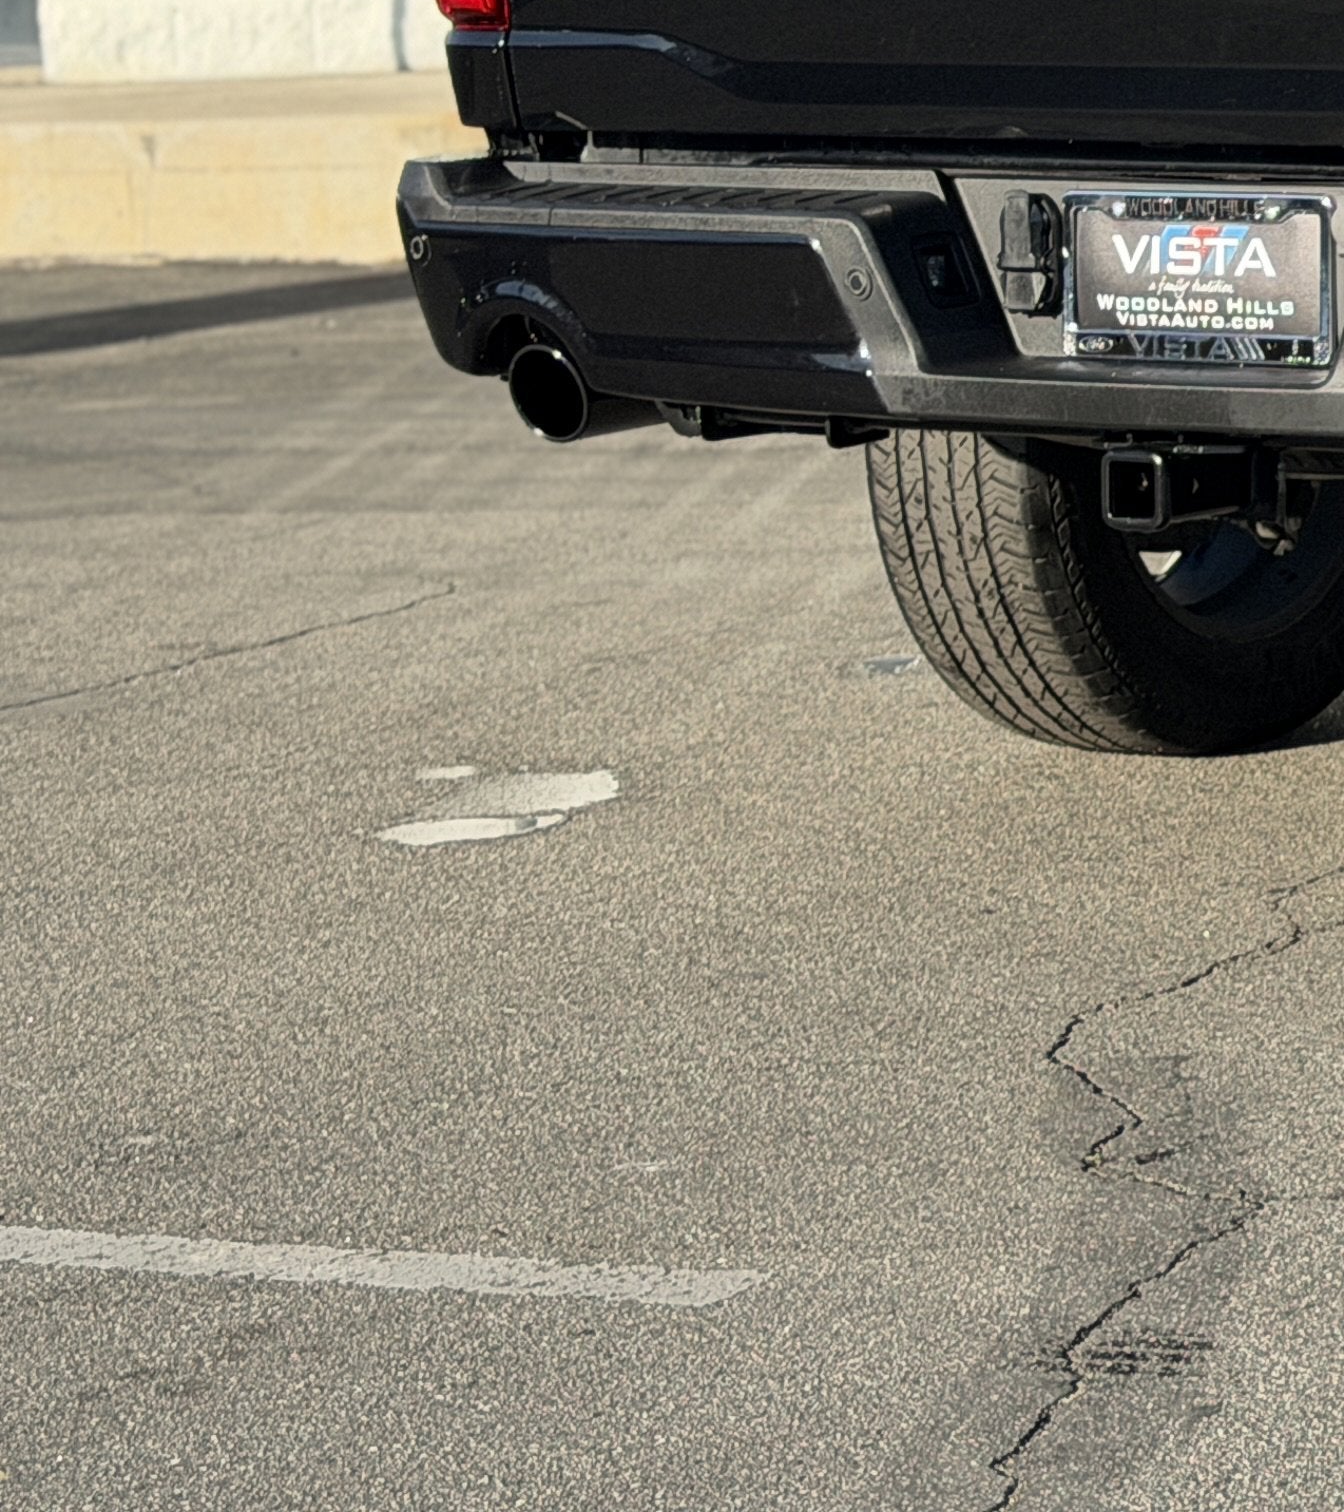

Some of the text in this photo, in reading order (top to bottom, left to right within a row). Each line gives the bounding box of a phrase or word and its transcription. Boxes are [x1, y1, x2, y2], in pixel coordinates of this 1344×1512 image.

[1111, 233, 1277, 278] VISTA
[1096, 293, 1295, 316] WOODLAND HILLS
